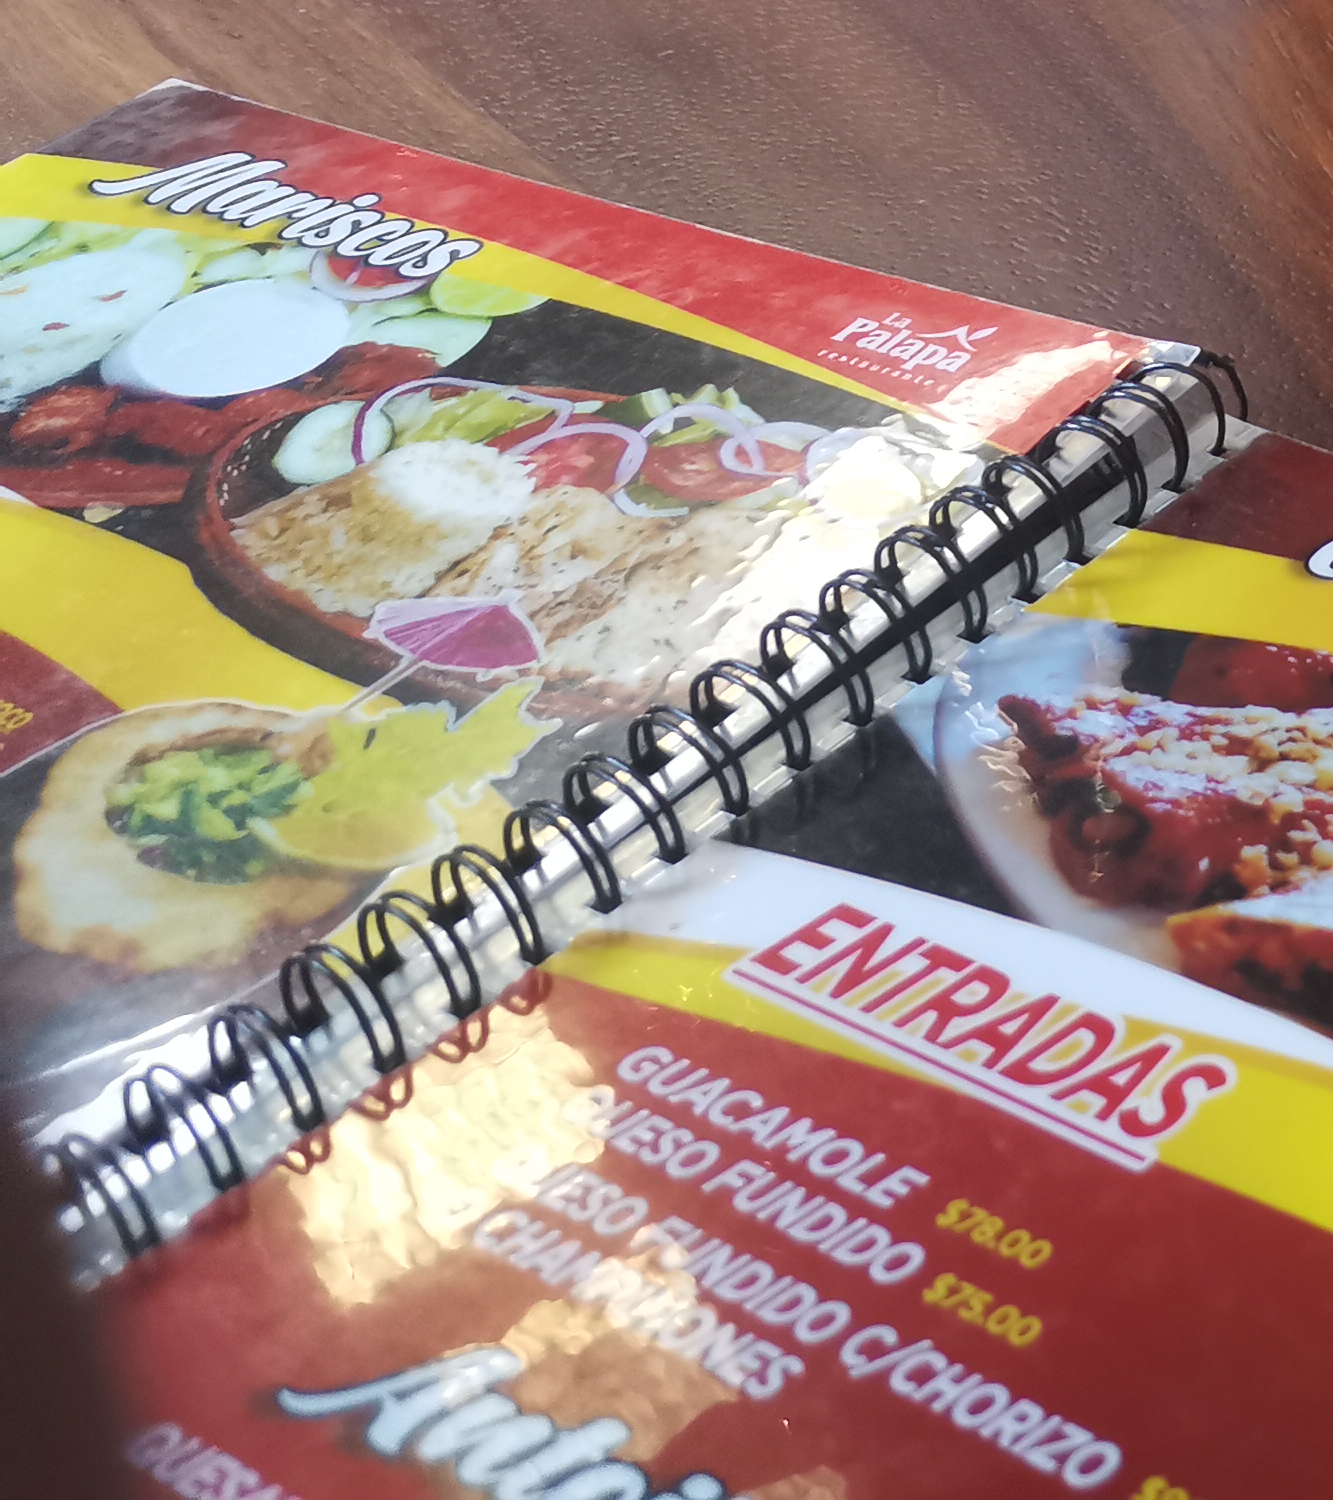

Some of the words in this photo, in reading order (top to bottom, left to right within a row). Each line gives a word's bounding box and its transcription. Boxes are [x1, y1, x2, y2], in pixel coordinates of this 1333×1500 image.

[89, 150, 484, 281] Mariscos
[881, 312, 912, 329] La
[830, 317, 972, 373] Palapa
[748, 902, 1227, 1139] ENTRADAS
[566, 1082, 721, 1181] QUESO
[702, 1156, 925, 1285] FUNDIDO
[922, 1272, 1042, 1349] $75.00
[616, 1044, 930, 1208] GUACAMOLE
[935, 1199, 1054, 1270] $78.00
[632, 1213, 852, 1345] FUNDIDO
[839, 1322, 1123, 1490] C/CHORIZO
